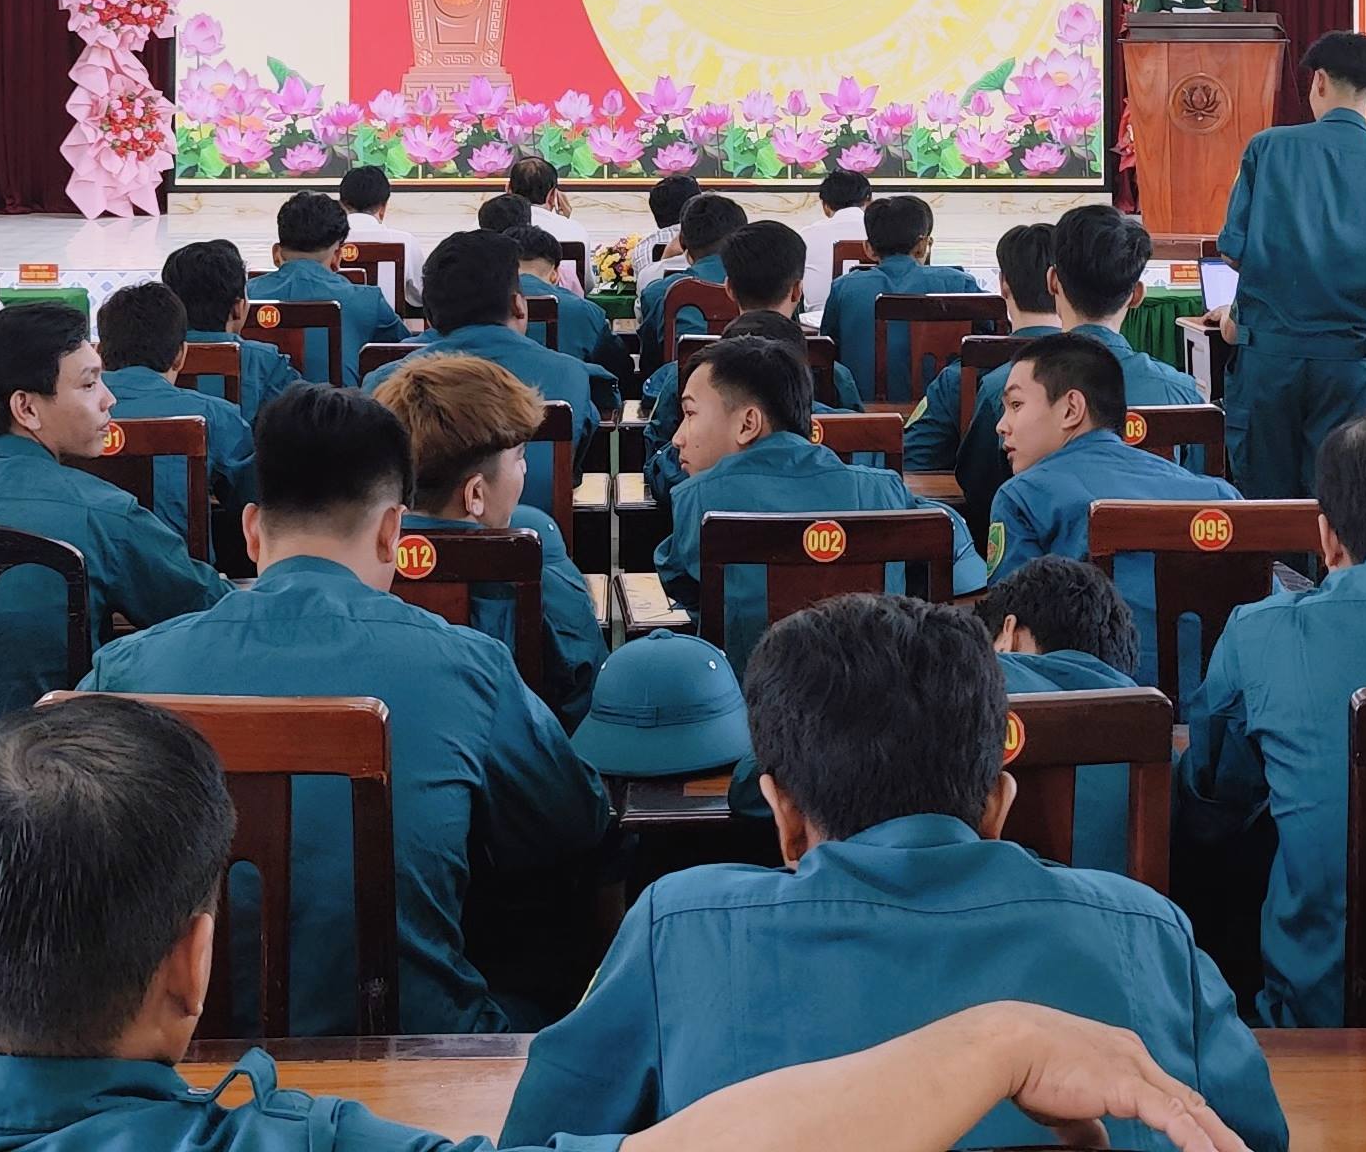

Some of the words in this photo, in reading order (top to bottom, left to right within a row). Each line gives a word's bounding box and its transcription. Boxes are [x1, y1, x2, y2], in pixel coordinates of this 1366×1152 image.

[258, 309, 278, 323] 041
[103, 430, 119, 447] 91
[1125, 421, 1142, 438] 03
[1194, 519, 1227, 541] 095
[806, 530, 841, 552] 002
[396, 545, 432, 568] 012
